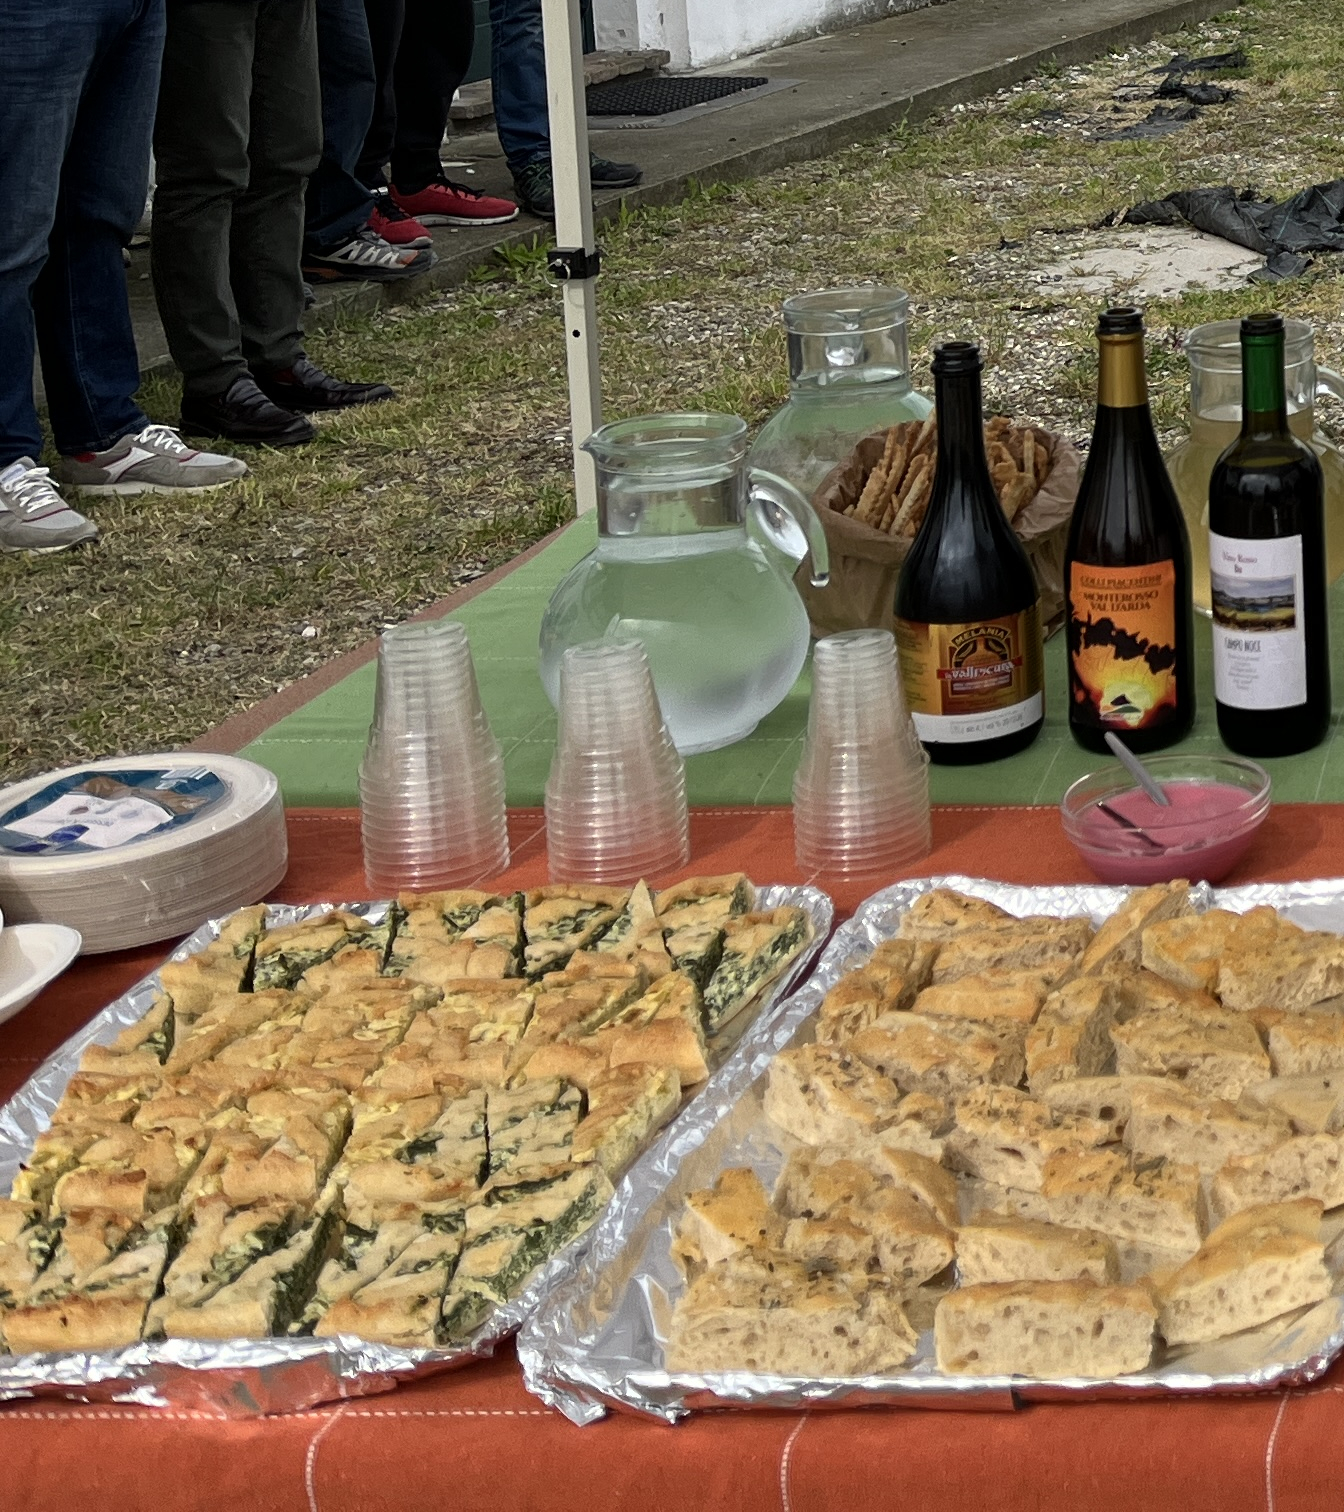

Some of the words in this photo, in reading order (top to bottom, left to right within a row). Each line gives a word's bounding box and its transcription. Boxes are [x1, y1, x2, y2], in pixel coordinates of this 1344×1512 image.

[1083, 589, 1159, 603] MONTEROSSO
[1090, 602, 1107, 612] VAL
[954, 627, 1006, 646] MELANIA
[1224, 637, 1243, 651] CAMPO
[1244, 640, 1261, 653] NOCE
